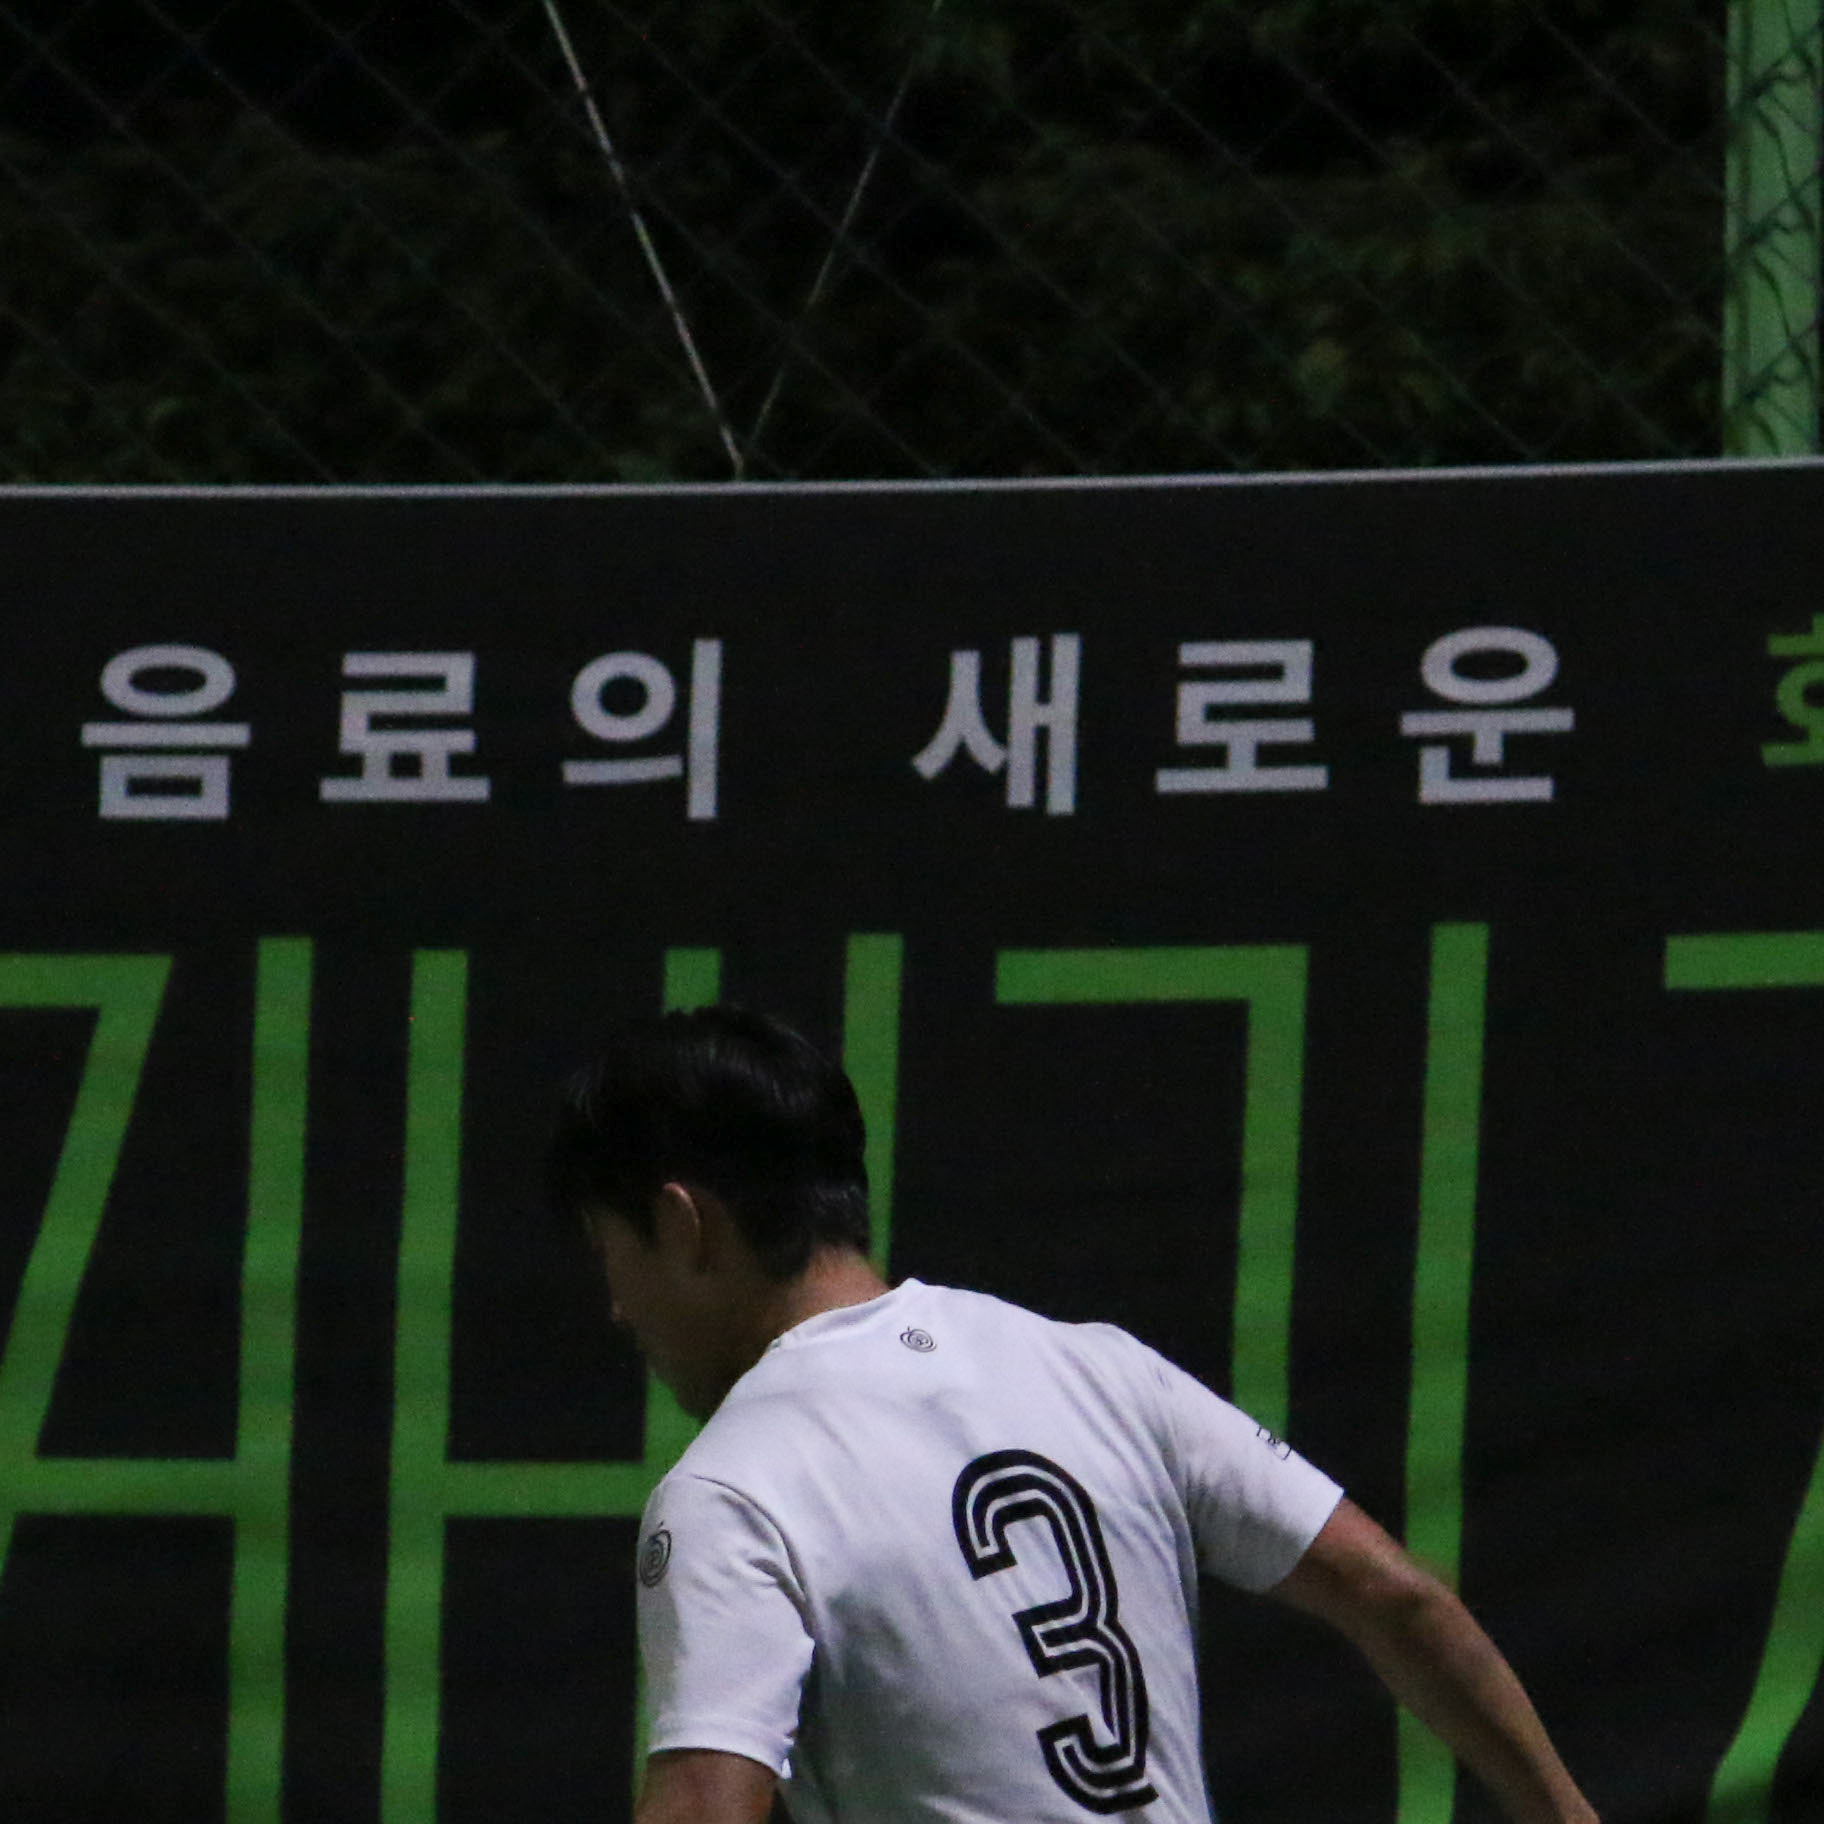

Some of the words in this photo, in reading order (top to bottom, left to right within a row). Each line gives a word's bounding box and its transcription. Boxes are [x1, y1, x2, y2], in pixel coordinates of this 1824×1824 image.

[79, 637, 724, 822] 음료의
[911, 624, 1577, 817] 새로운
[952, 1449, 1160, 1817] 3
